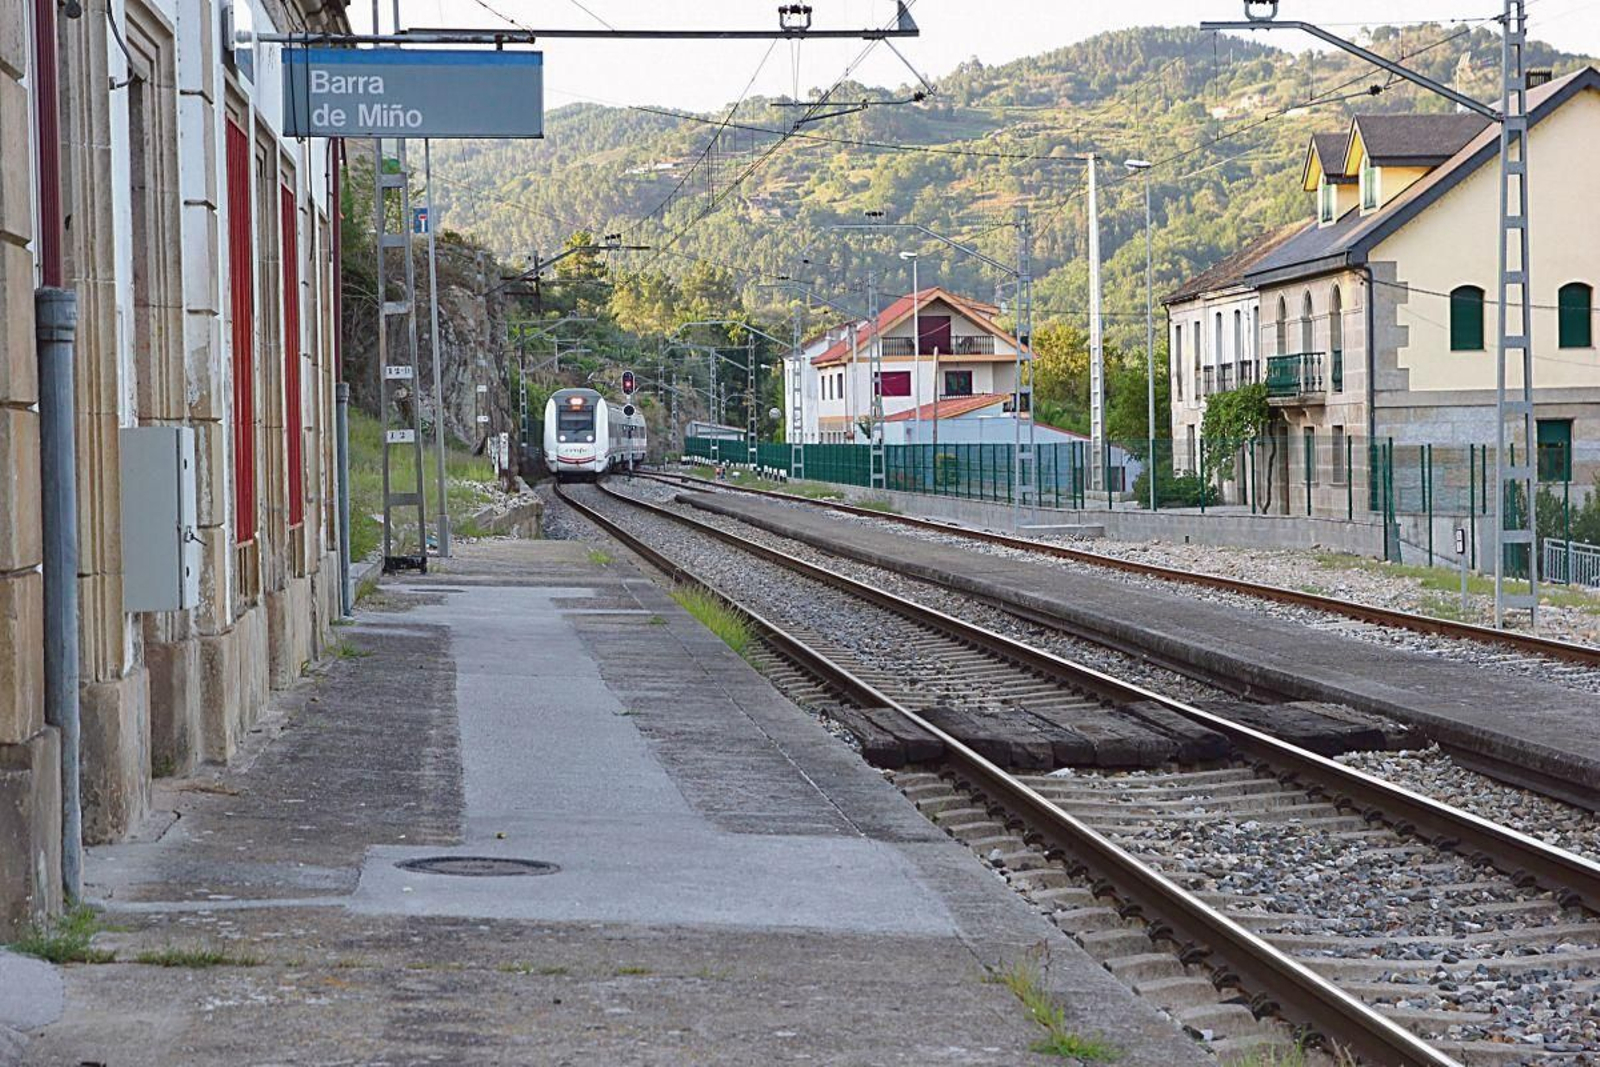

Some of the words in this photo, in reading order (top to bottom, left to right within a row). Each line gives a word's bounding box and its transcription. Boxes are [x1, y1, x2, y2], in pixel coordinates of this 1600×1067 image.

[311, 70, 385, 94] Barra
[312, 103, 346, 127] de
[358, 103, 423, 128] Miño
